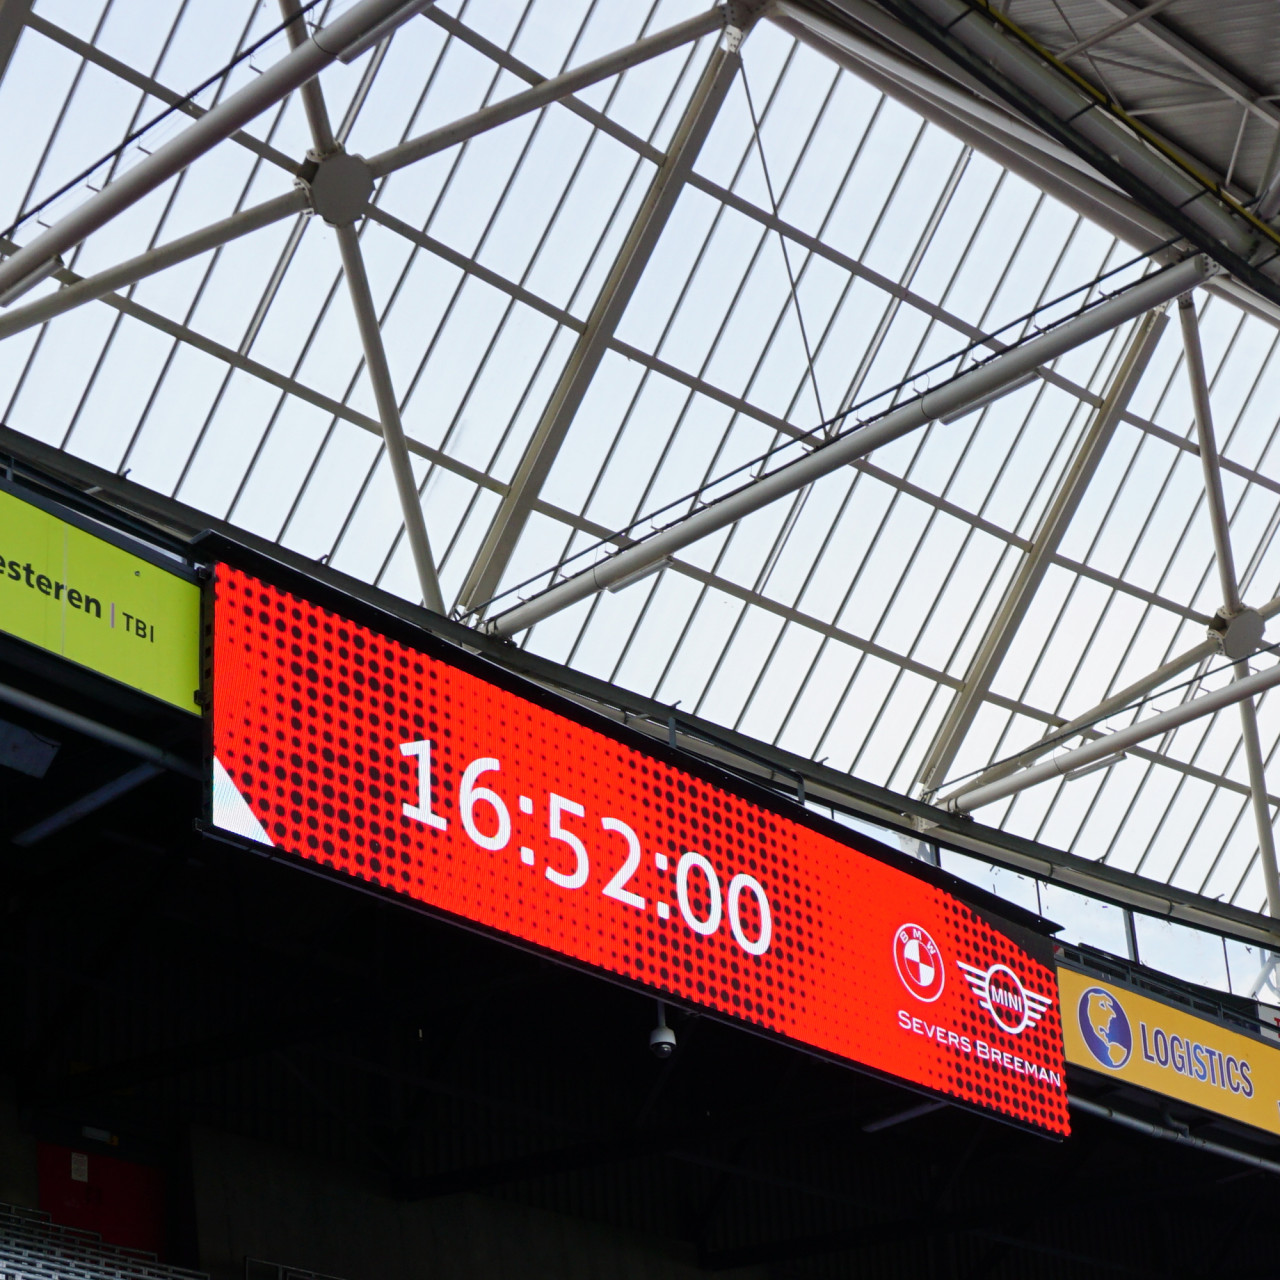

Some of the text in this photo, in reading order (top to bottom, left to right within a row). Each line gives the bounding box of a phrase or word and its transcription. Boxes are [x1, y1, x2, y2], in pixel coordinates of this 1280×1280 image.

[121, 611, 155, 643] TBI
[399, 738, 773, 957] 16:52:00
[899, 928, 937, 956] BMW
[990, 985, 1024, 1013] MINI
[897, 1009, 1062, 1088] SEVERS BREEMAN
[1140, 1022, 1254, 1099] LOGISTICS
